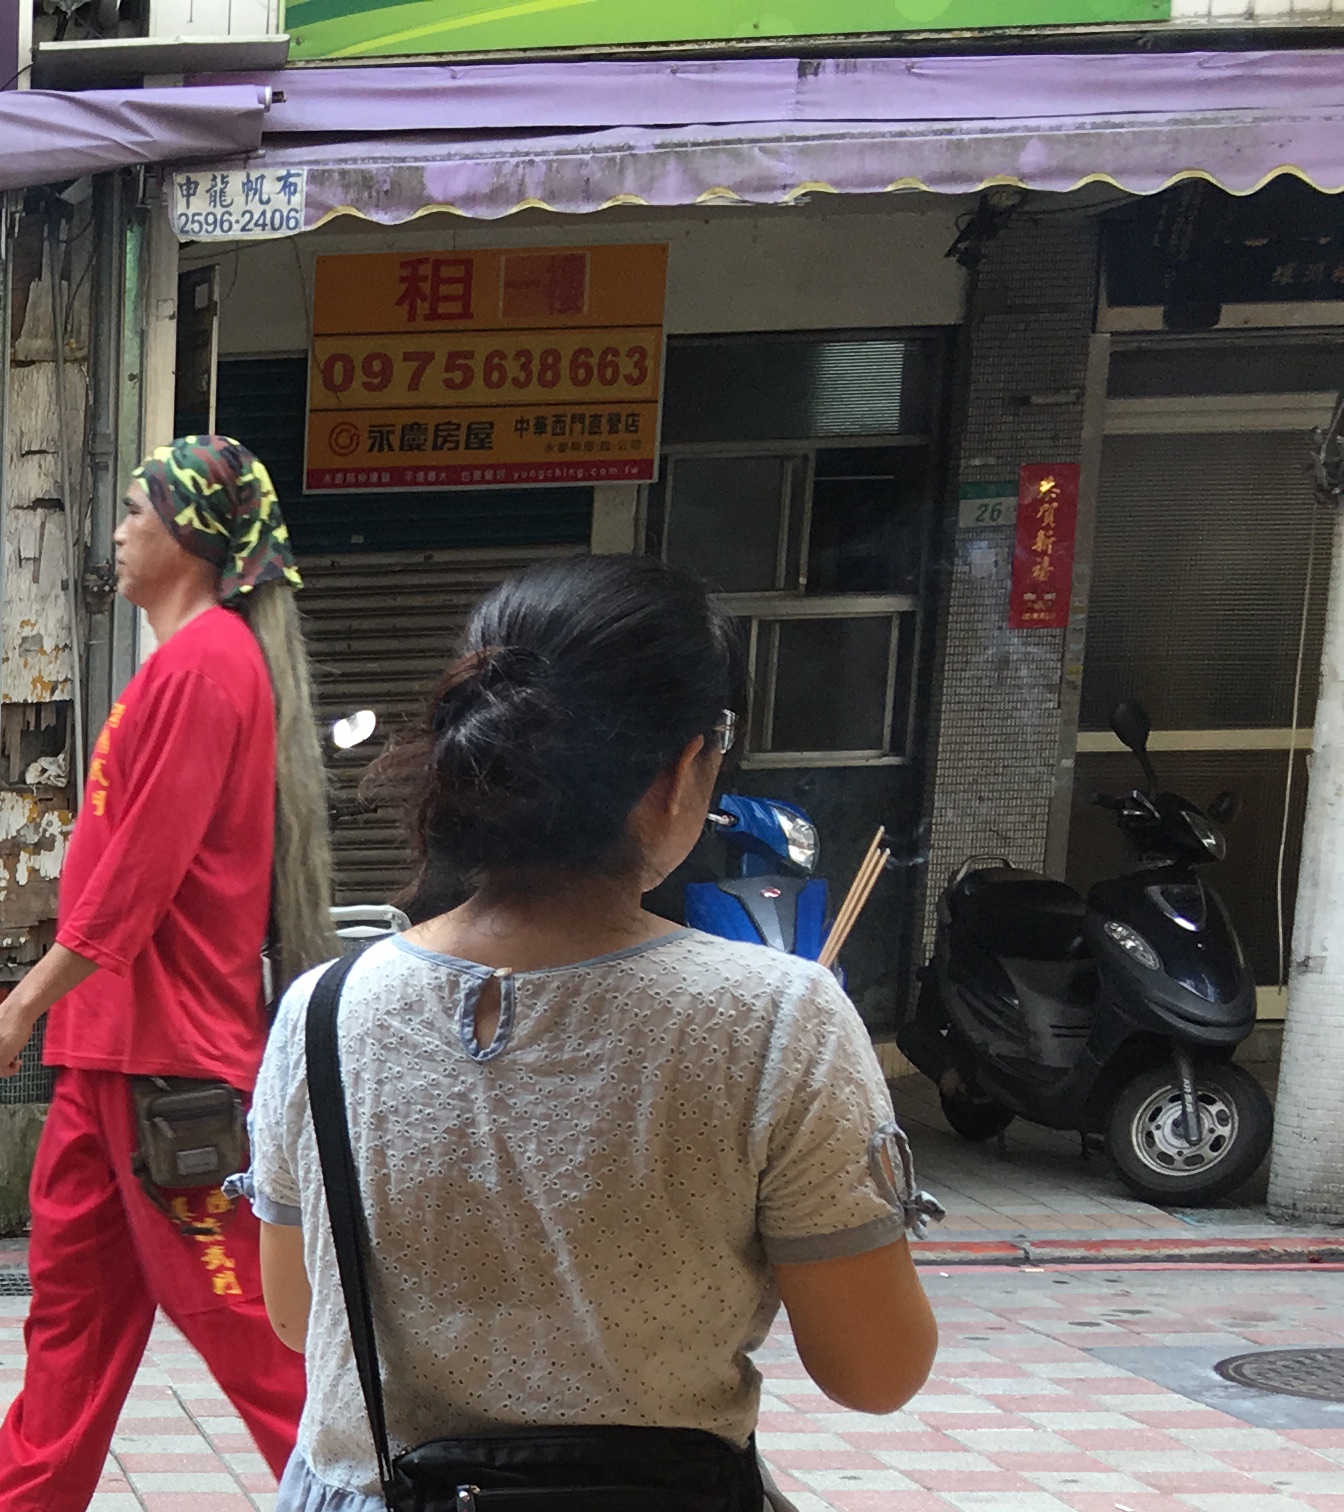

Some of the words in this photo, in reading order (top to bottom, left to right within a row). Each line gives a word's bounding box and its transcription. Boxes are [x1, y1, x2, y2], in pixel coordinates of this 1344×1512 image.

[176, 169, 302, 210] 申龍帆布
[394, 256, 475, 322] 租
[321, 345, 649, 393] 0975638663
[367, 420, 495, 454] 永慶房屋
